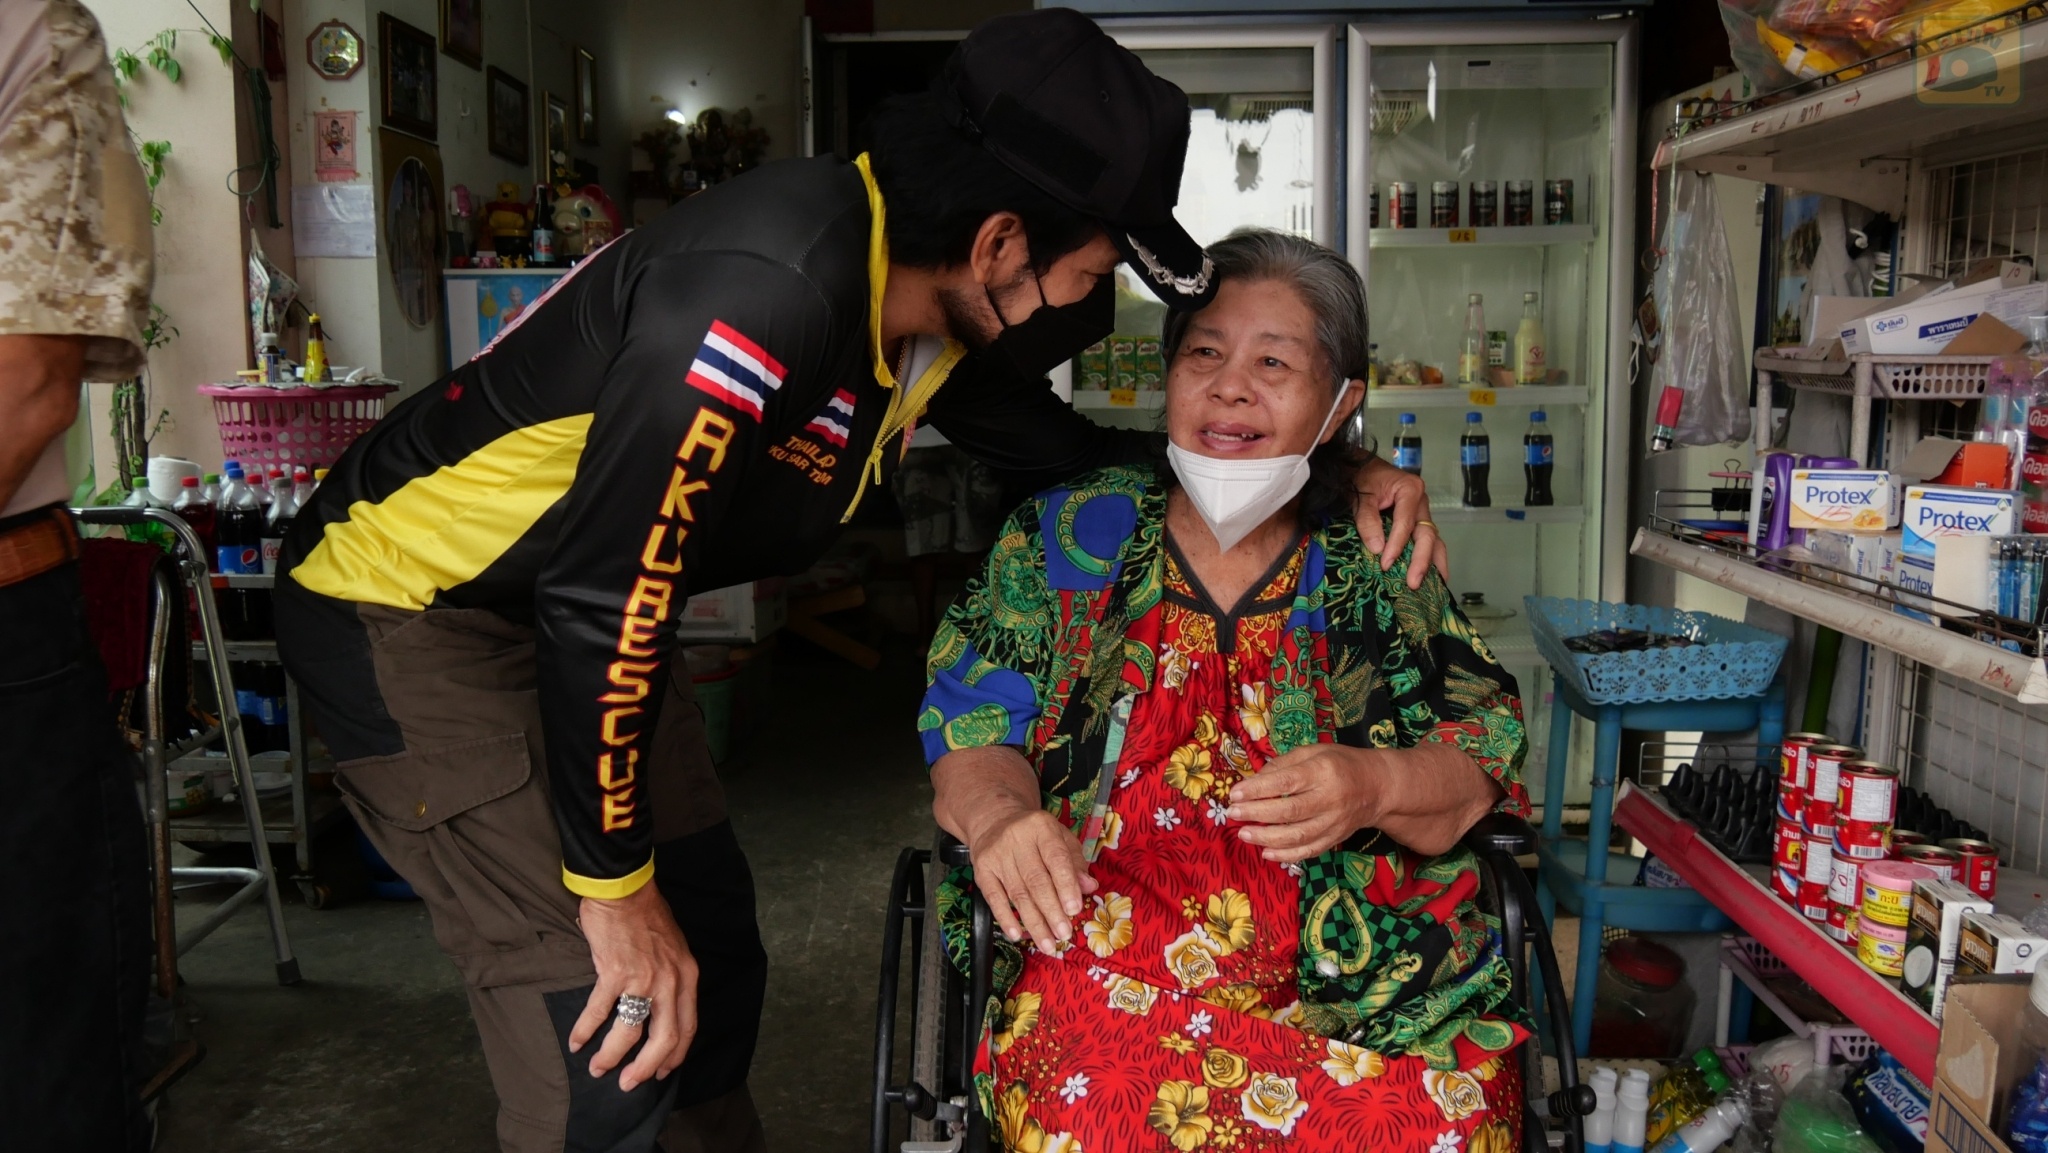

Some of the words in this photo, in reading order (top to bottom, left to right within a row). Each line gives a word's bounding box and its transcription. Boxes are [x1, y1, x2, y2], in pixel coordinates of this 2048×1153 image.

[2006, 266, 2021, 279] 10
[1806, 486, 1875, 505] Protex
[1919, 506, 1994, 532] Protex
[1900, 569, 1933, 596] Protex
[597, 574, 675, 833] RESCUE
